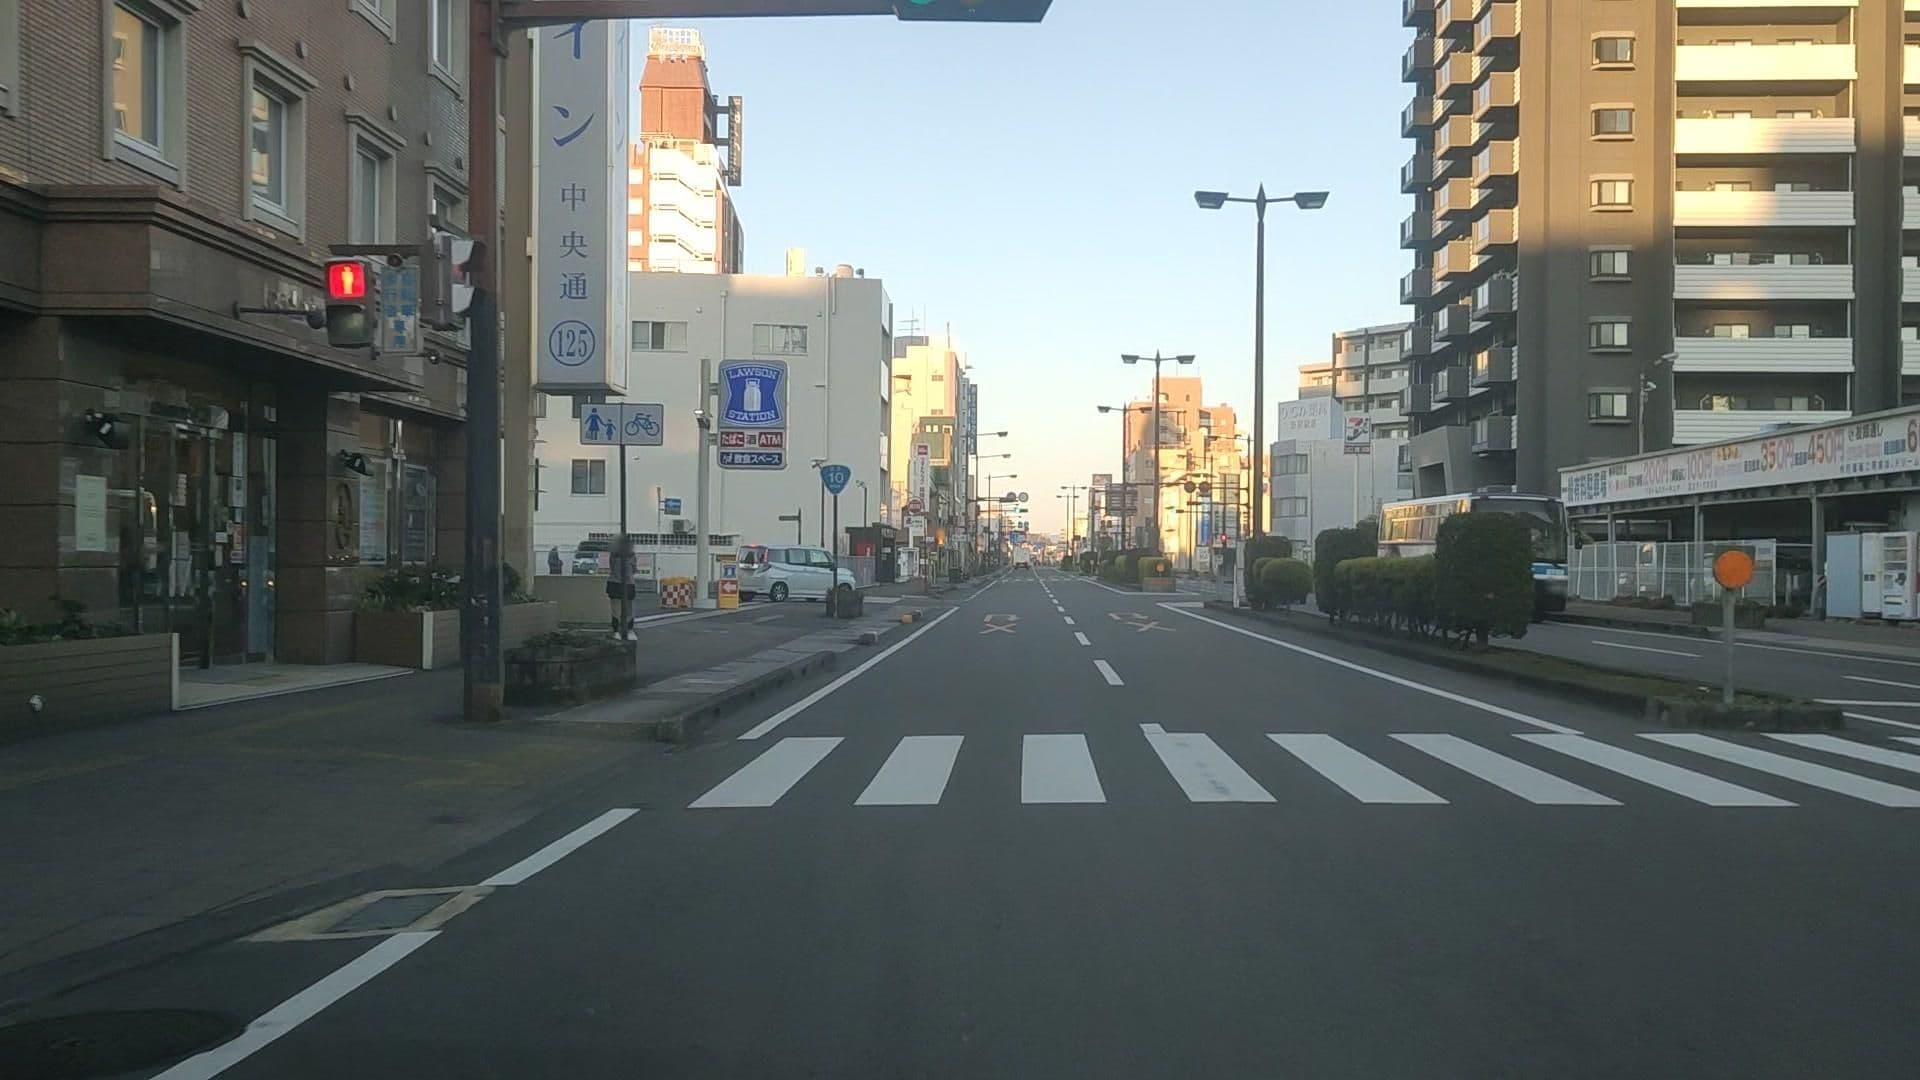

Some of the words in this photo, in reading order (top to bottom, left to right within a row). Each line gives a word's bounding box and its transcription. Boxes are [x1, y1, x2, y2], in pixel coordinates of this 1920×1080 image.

[560, 183, 588, 301] 中央通
[556, 329, 588, 358] 125
[728, 367, 778, 380] LAWSON
[728, 409, 776, 421] STATION
[721, 433, 745, 446] たばこ
[759, 433, 782, 446] ATM
[1808, 427, 1845, 465] 450円
[1687, 452, 1712, 481] 100円
[1760, 437, 1794, 472] 350円
[824, 472, 844, 484] 10
[1642, 457, 1669, 486] 200円
